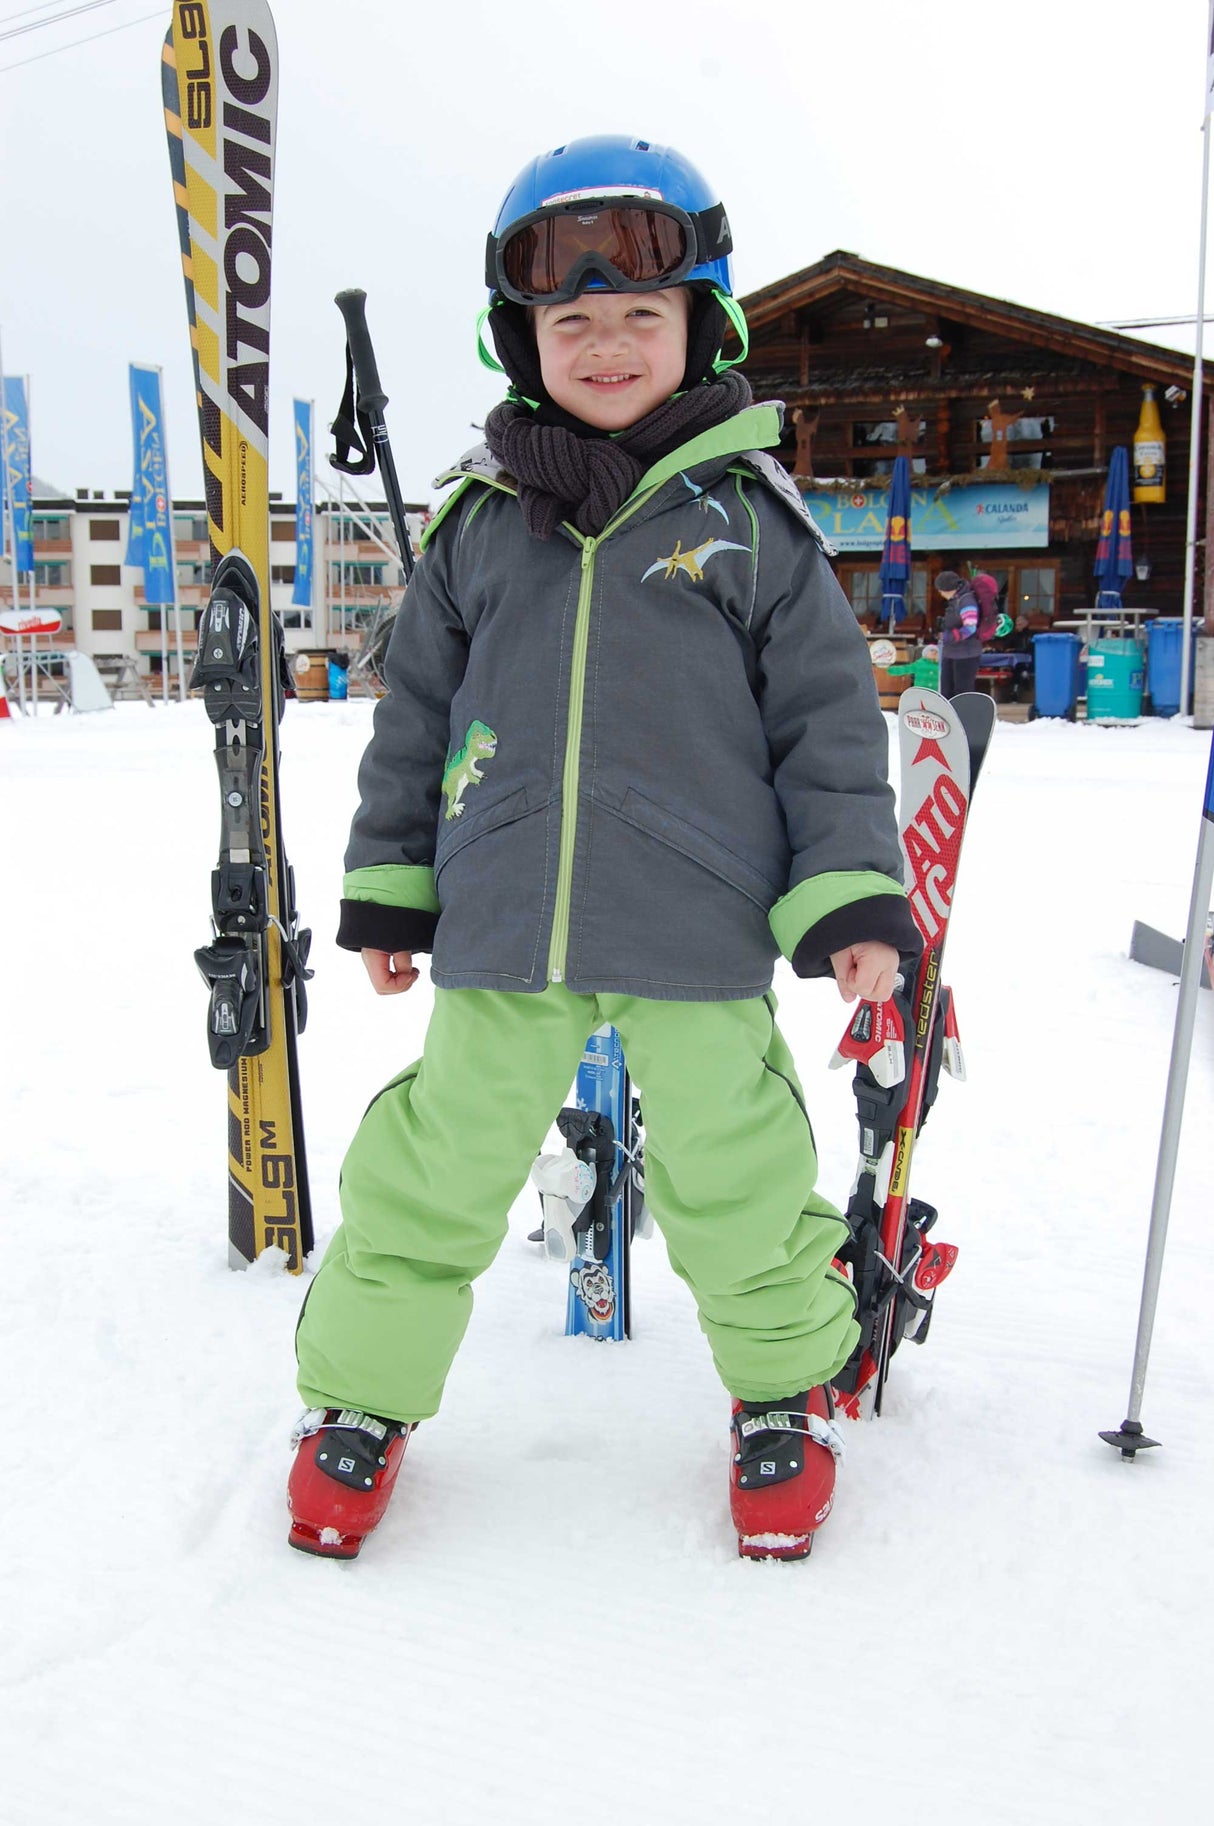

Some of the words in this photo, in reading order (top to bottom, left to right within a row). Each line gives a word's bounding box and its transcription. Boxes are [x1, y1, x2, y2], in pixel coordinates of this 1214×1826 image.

[179, 0, 212, 129] SL9
[219, 24, 271, 439] ATOMIC
[837, 491, 928, 510] BOLGN
[985, 502, 1029, 514] CALANDA
[915, 950, 940, 1049] redster
[240, 1058, 249, 1114] MAGNESIUM
